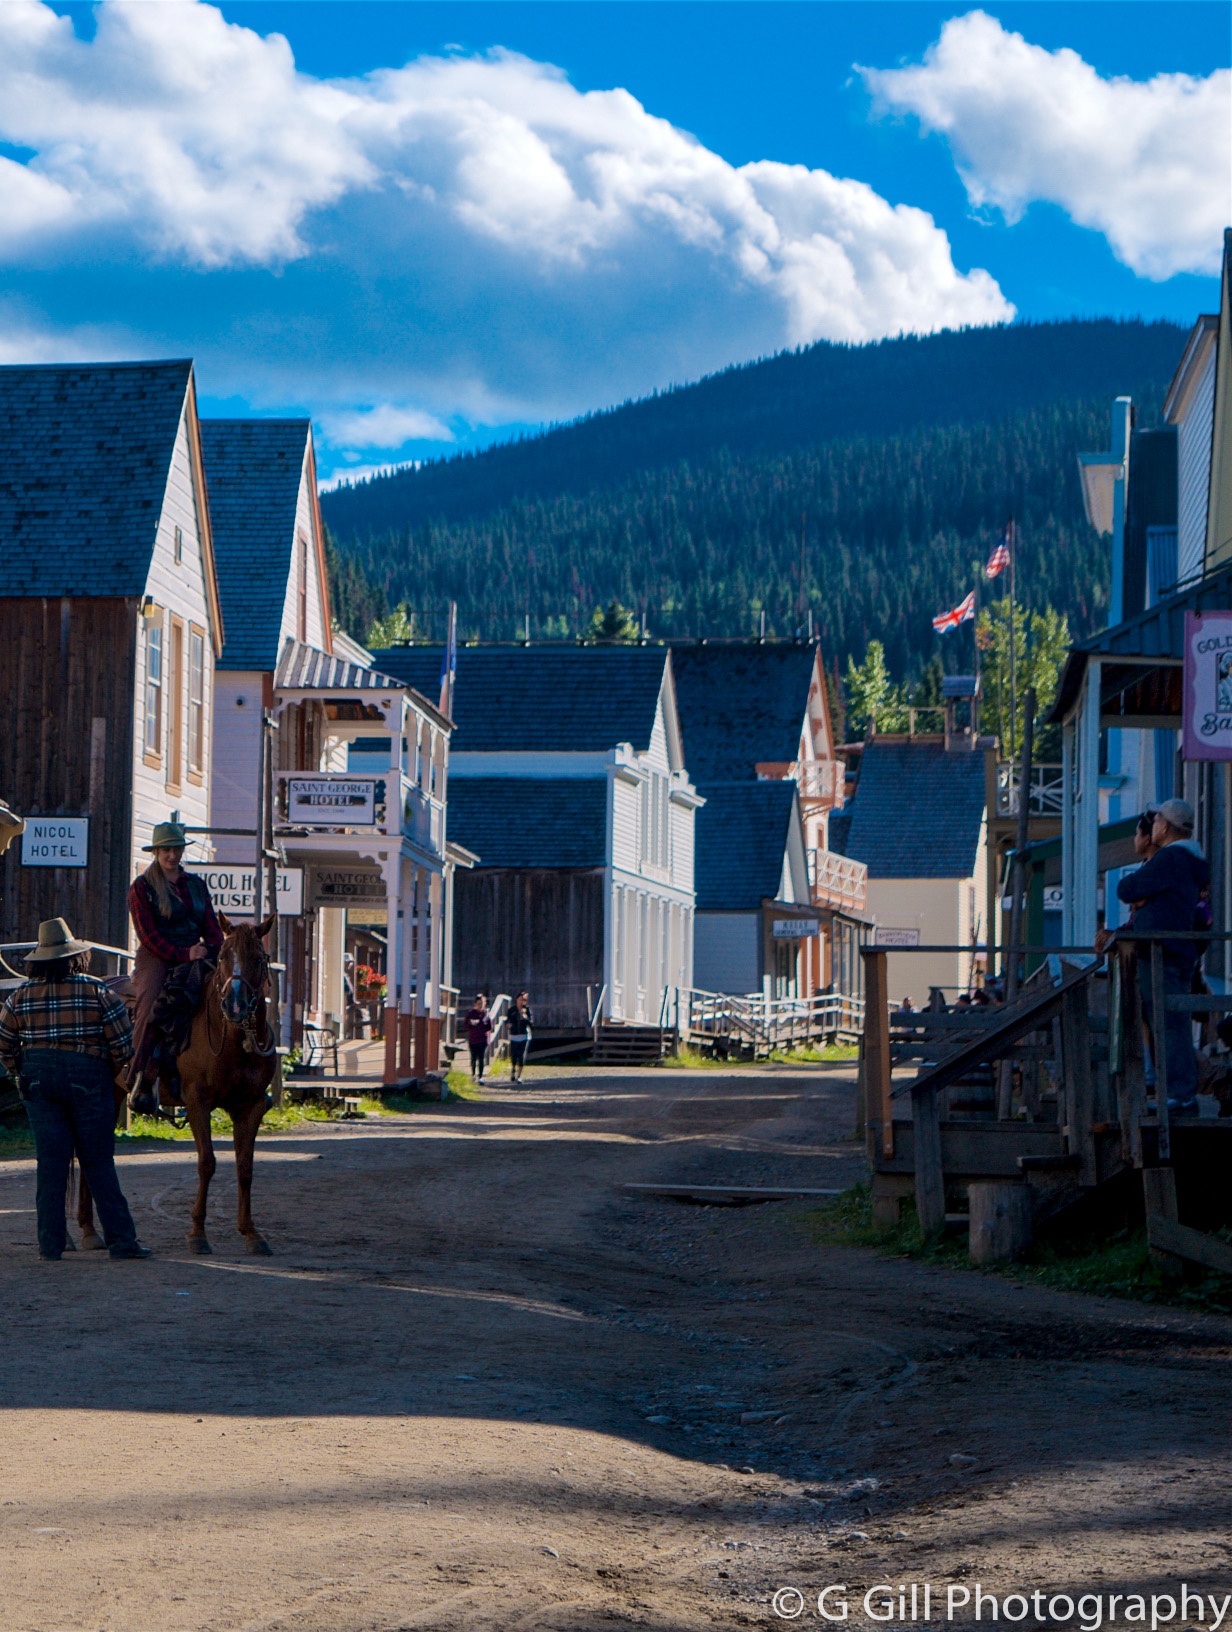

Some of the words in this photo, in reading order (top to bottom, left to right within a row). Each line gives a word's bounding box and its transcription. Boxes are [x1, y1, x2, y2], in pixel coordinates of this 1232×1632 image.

[292, 783, 326, 792] SAINT
[328, 783, 372, 793] GEORGE
[310, 795, 354, 805] HOTEL
[34, 826, 76, 838] NICOL
[31, 845, 78, 857] HOTEL
[197, 872, 237, 890] ICOL
[242, 874, 291, 892] HTEL
[316, 872, 354, 883] SAINT
